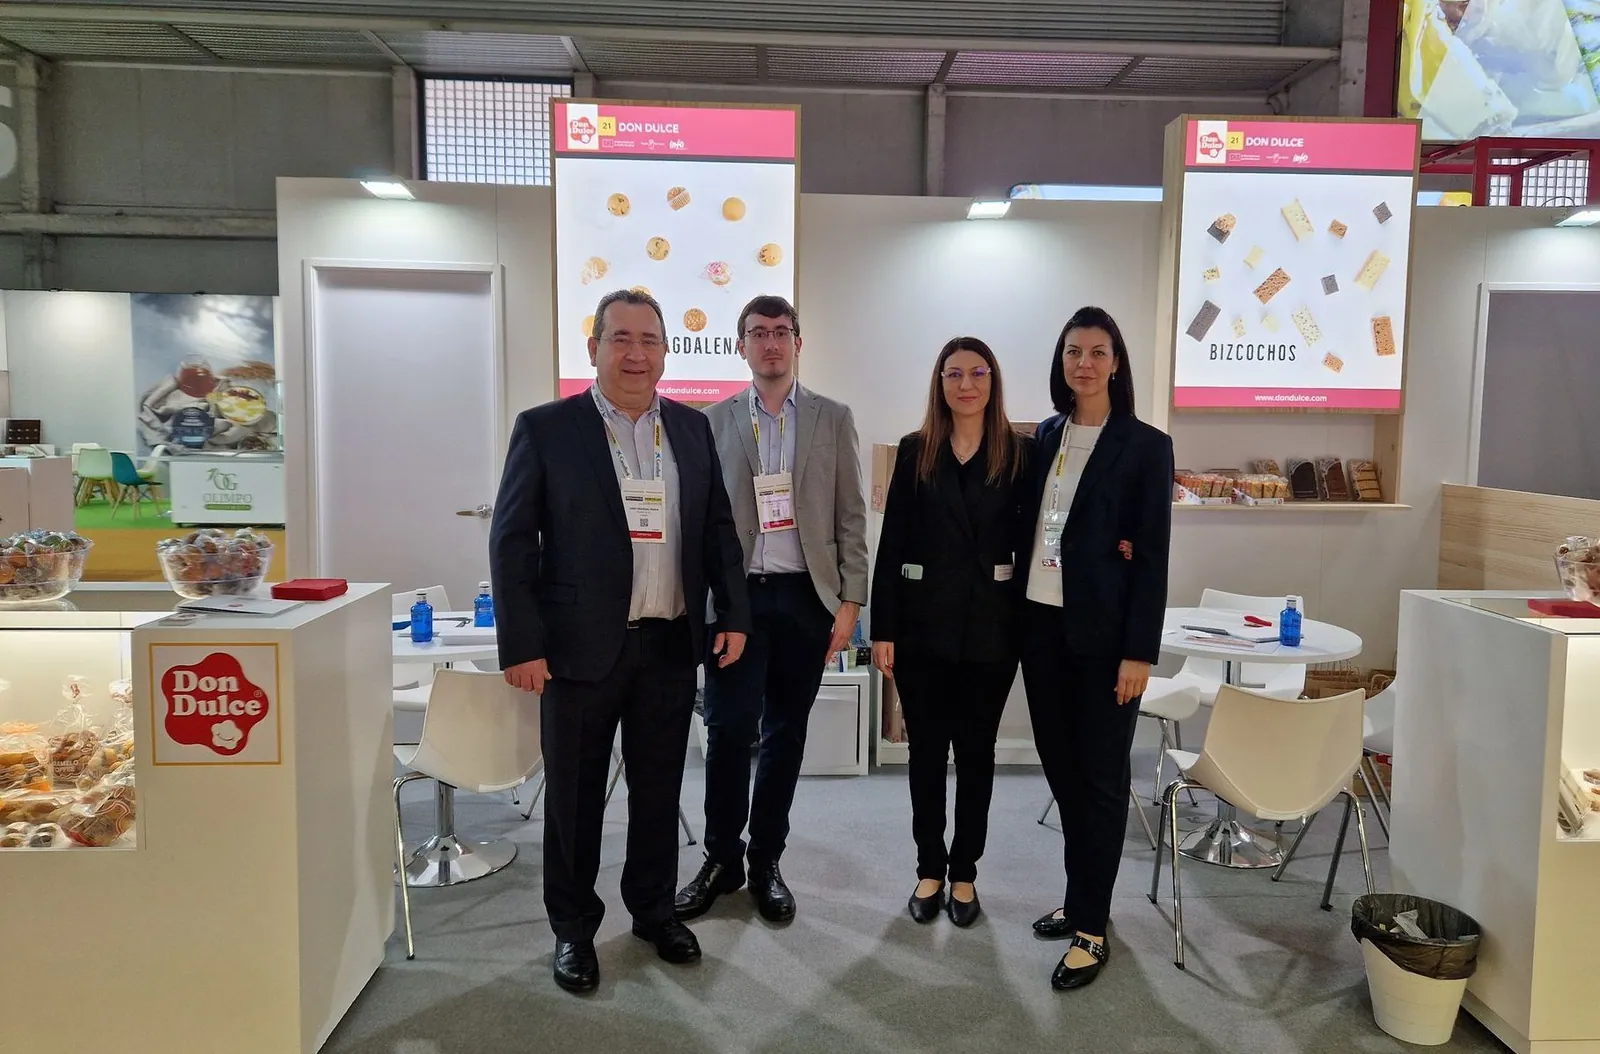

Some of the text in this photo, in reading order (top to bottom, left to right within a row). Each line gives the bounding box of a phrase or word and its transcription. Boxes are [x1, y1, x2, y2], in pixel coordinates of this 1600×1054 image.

[602, 122, 611, 130] 21
[618, 122, 679, 133] DON DULCE
[1230, 136, 1239, 144] 21
[1246, 136, 1304, 148] DON DULCE
[1209, 343, 1297, 361] BIZCOCHOS
[1254, 393, 1328, 403] www.dondulce.com
[202, 493, 253, 504] OLIMPO
[172, 670, 240, 692] Don
[172, 694, 262, 716] Dulce
